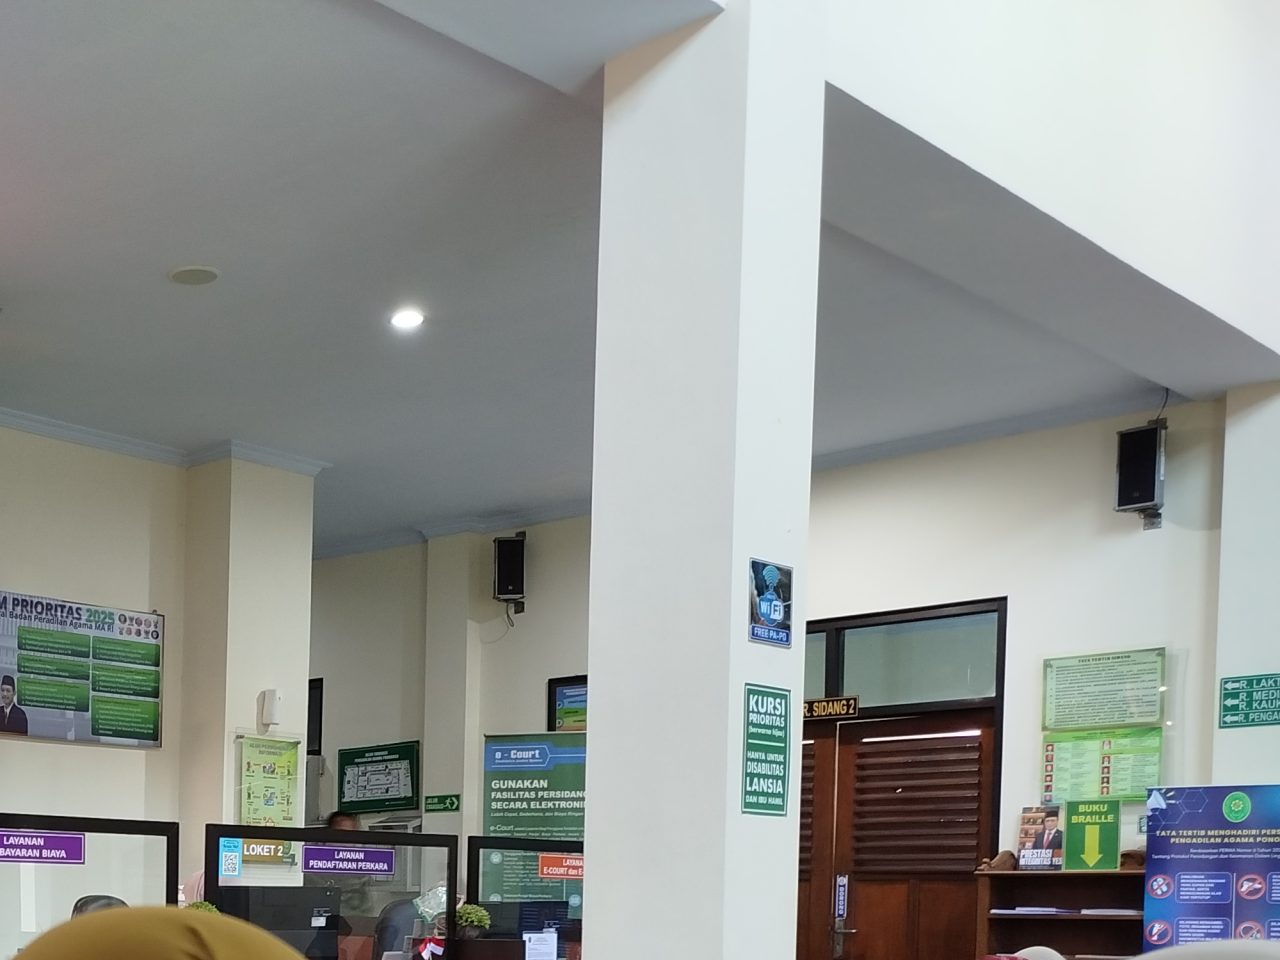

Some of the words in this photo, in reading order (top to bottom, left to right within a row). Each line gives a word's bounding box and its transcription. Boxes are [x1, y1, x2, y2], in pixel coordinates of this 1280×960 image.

[12, 597, 82, 621] PRIORITAS
[85, 607, 115, 624] 2025
[9, 611, 32, 621] Badan
[34, 614, 67, 627] Peradilan
[69, 619, 93, 630] Agama
[754, 627, 768, 637] FREE
[1239, 681, 1250, 689] R.
[1239, 692, 1250, 701] R.
[749, 694, 785, 716] KURSI
[813, 700, 847, 716] SIDANG
[848, 699, 855, 713] 2
[1239, 701, 1250, 710] R.
[748, 712, 785, 728] PRIORITAS
[510, 750, 540, 759] Court
[746, 761, 784, 777] DISABILITAS
[491, 779, 548, 789] GUNAKAN
[745, 776, 784, 794] LANSIA
[490, 791, 536, 799] FASILITAS
[490, 801, 528, 809] SECARA
[530, 800, 585, 809] ELEKTRONI
[1078, 803, 1108, 812] BUKU
[1071, 814, 1114, 824] BRAILLE
[3, 835, 44, 847] LAYANAN
[41, 848, 67, 860] BIAYA
[243, 844, 276, 856] LOKET
[277, 846, 283, 857] 2
[334, 851, 365, 860] LAYANAN
[309, 860, 356, 870] PENDAFTARAN
[357, 862, 388, 870] PERKARA
